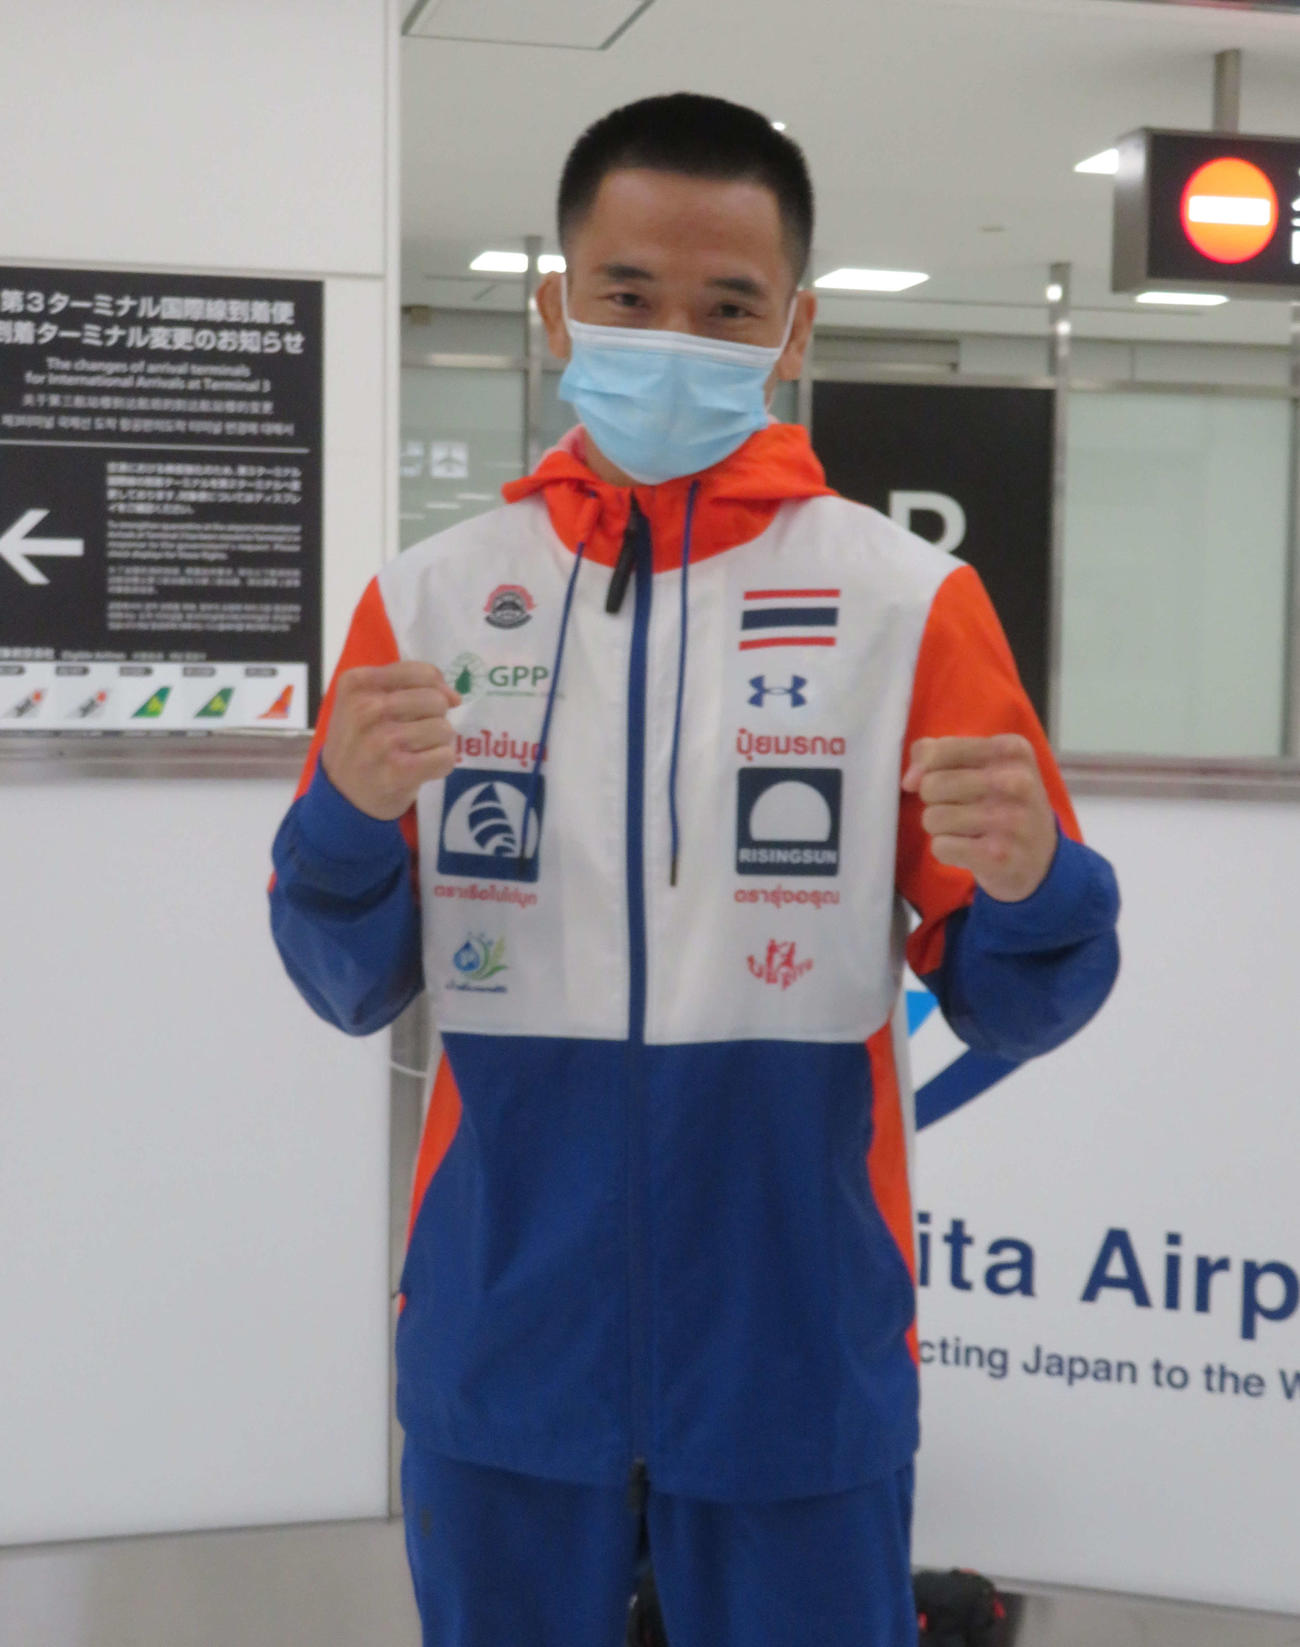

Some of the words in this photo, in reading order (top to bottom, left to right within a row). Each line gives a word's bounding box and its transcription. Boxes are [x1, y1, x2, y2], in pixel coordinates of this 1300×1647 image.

[487, 665, 550, 687] GPP
[738, 849, 837, 864] RISINGSUN
[1079, 1227, 1300, 1341] Airp
[1022, 1345, 1138, 1387] Japan
[1152, 1359, 1190, 1391] to
[1204, 1363, 1266, 1399] the
